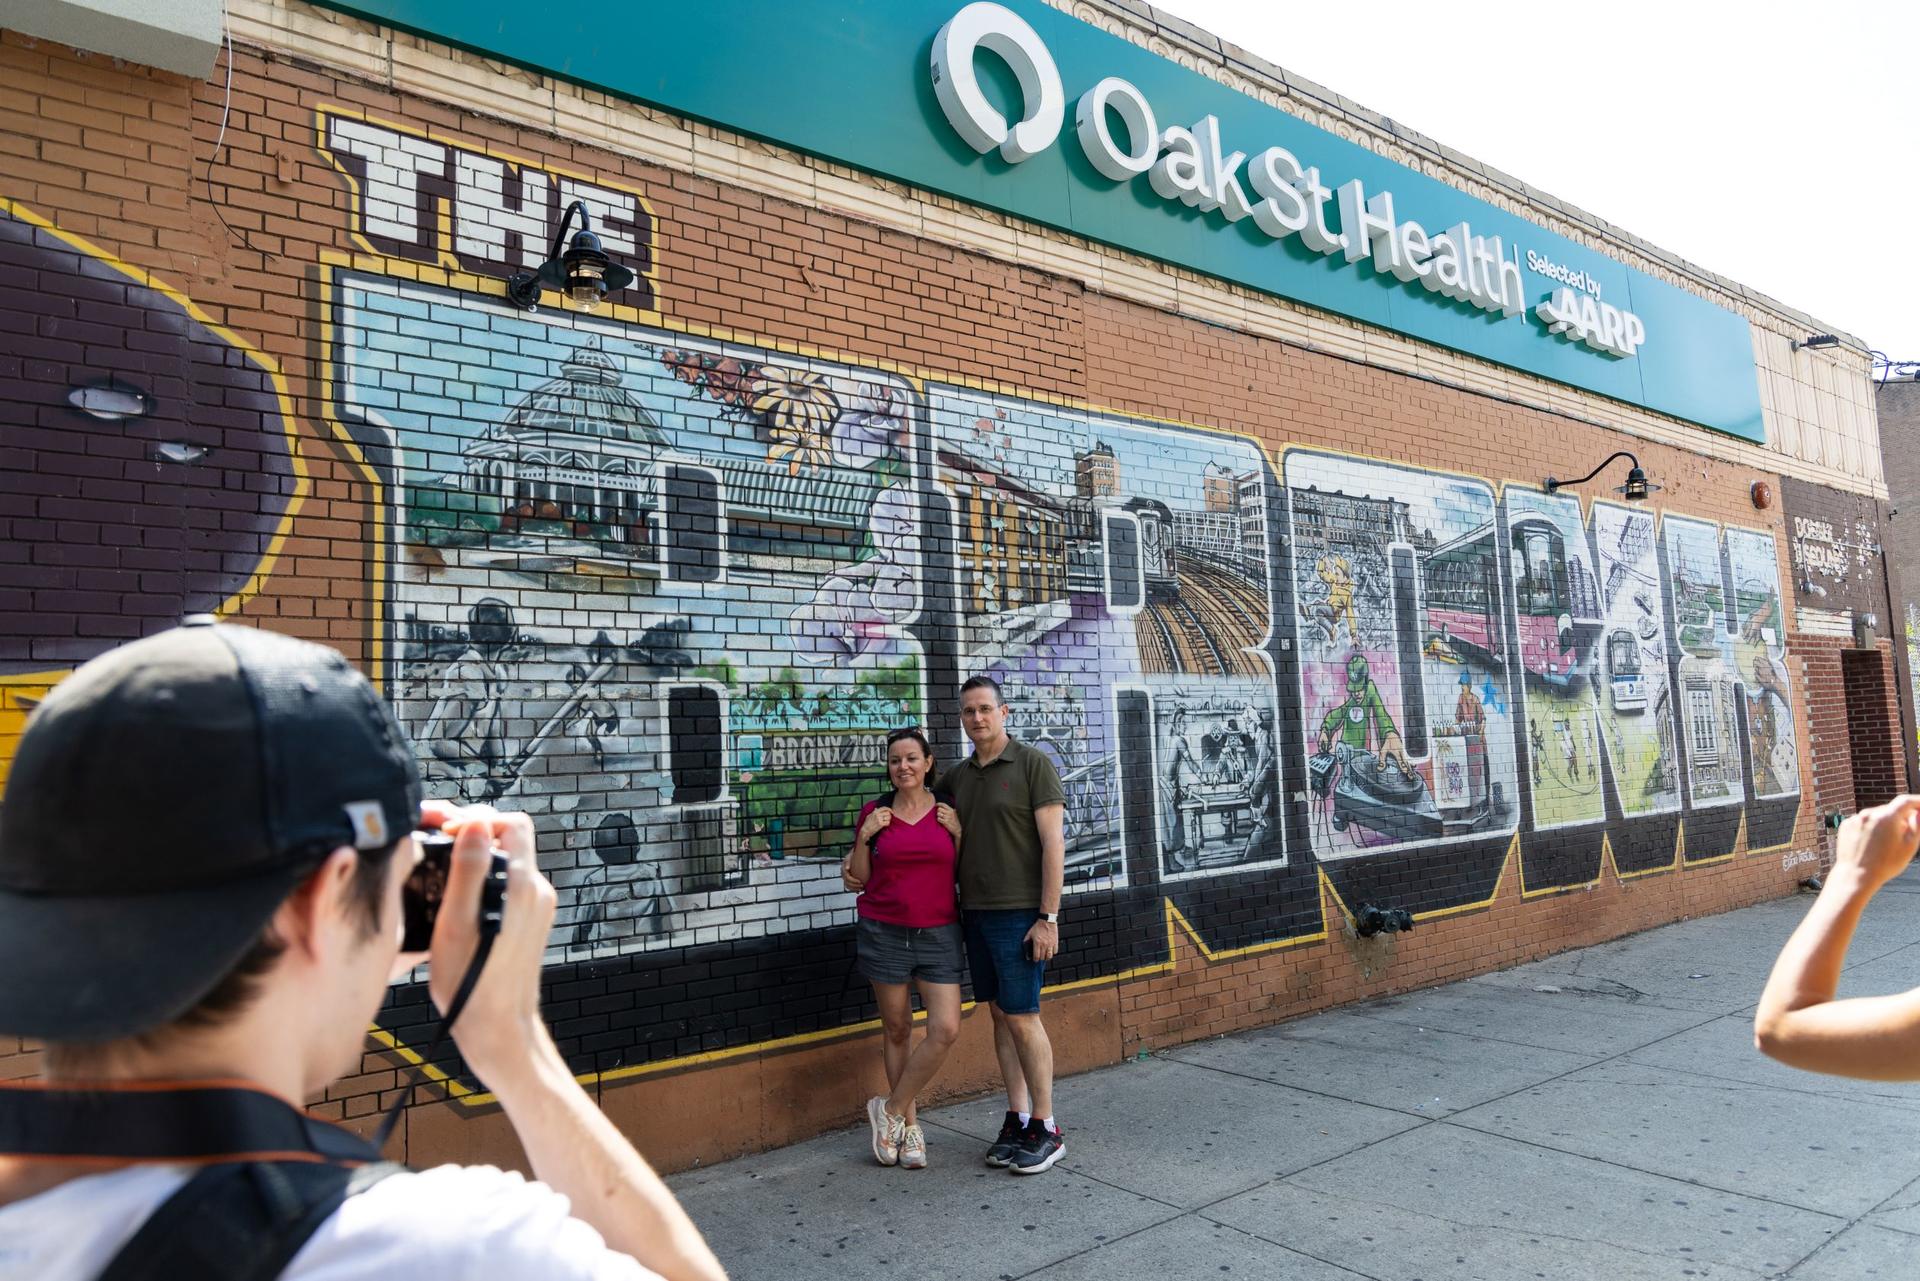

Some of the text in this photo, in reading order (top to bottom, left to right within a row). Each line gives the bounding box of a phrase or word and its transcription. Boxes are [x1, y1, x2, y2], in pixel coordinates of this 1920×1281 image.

[330, 117, 638, 291] THE
[1080, 77, 1253, 222] Oak
[1250, 147, 1350, 254] St.
[1340, 179, 1525, 318] Health
[1526, 249, 1601, 301] Selected by
[1539, 287, 1646, 358] AARP
[772, 735, 843, 769] BRONX
